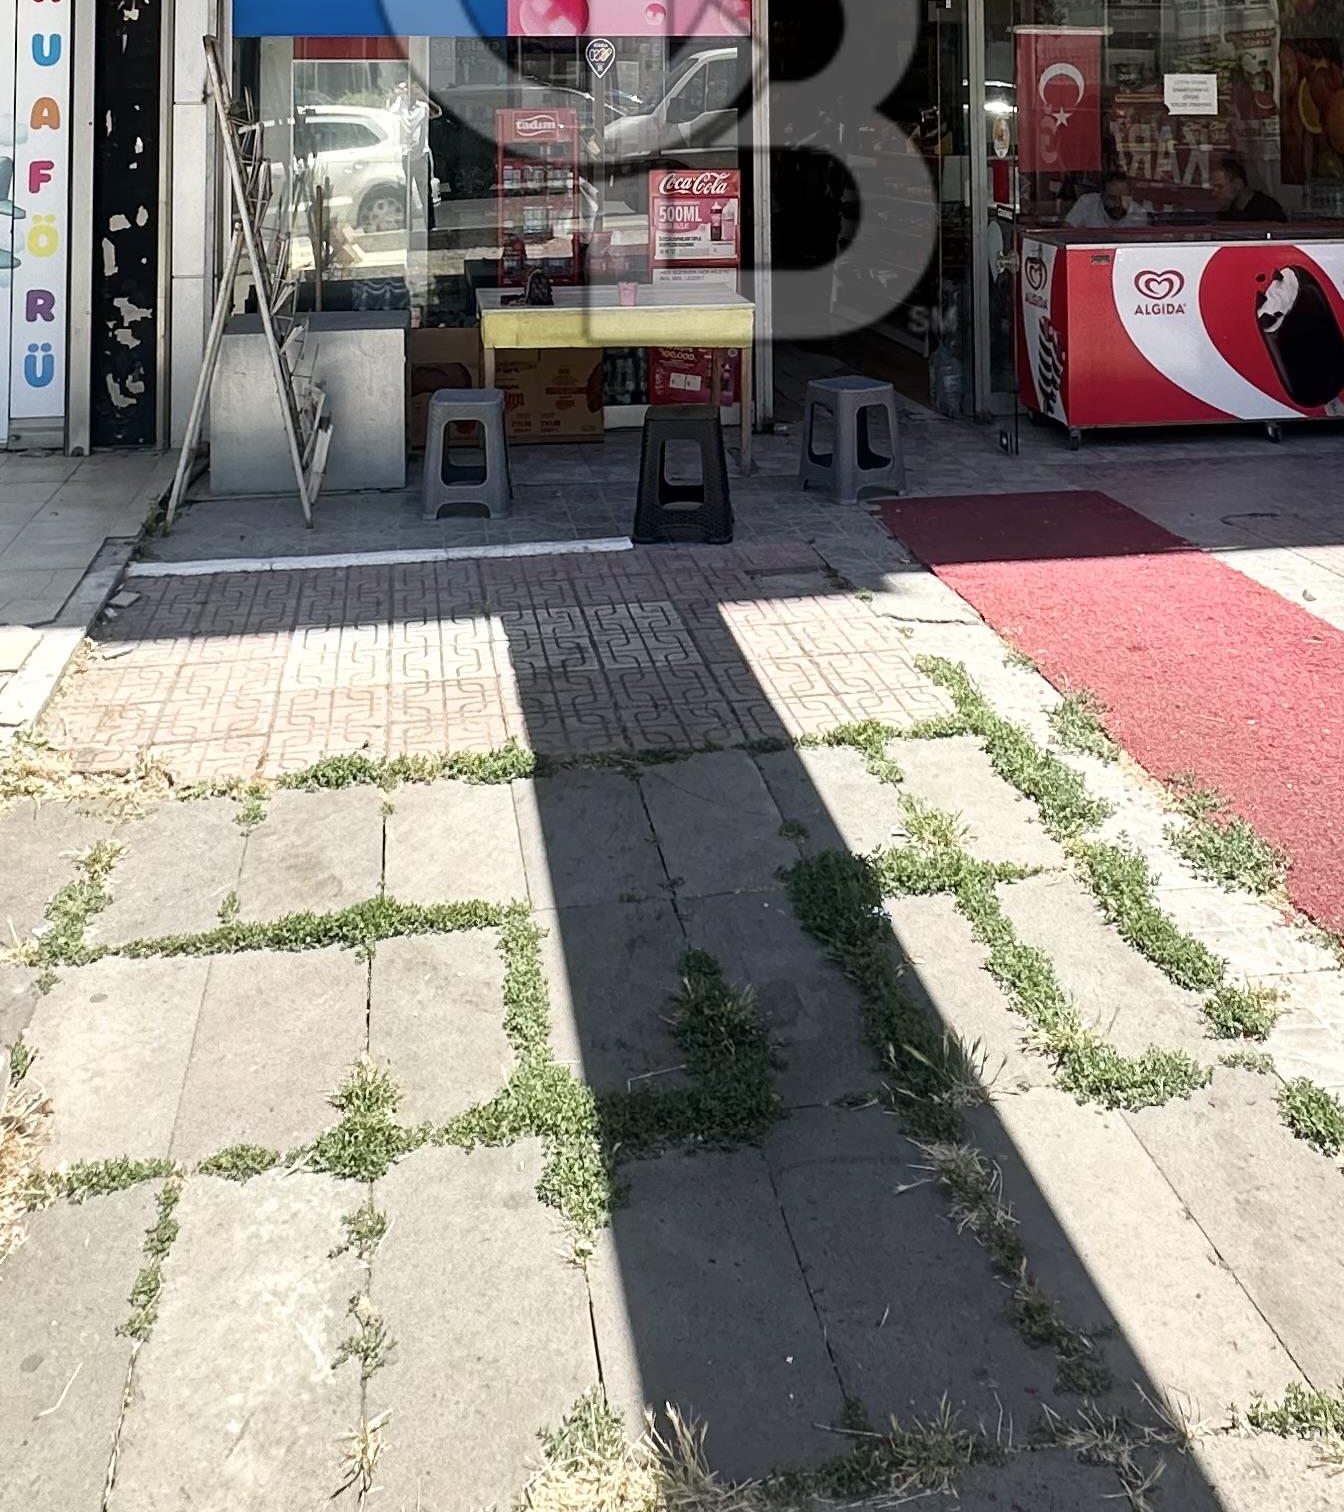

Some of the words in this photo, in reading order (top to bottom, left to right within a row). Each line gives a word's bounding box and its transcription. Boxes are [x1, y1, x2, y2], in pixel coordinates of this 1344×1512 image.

[659, 172, 730, 195] Coca-Cola
[659, 206, 702, 222] 500ML
[1134, 304, 1186, 316] ALGIDA
